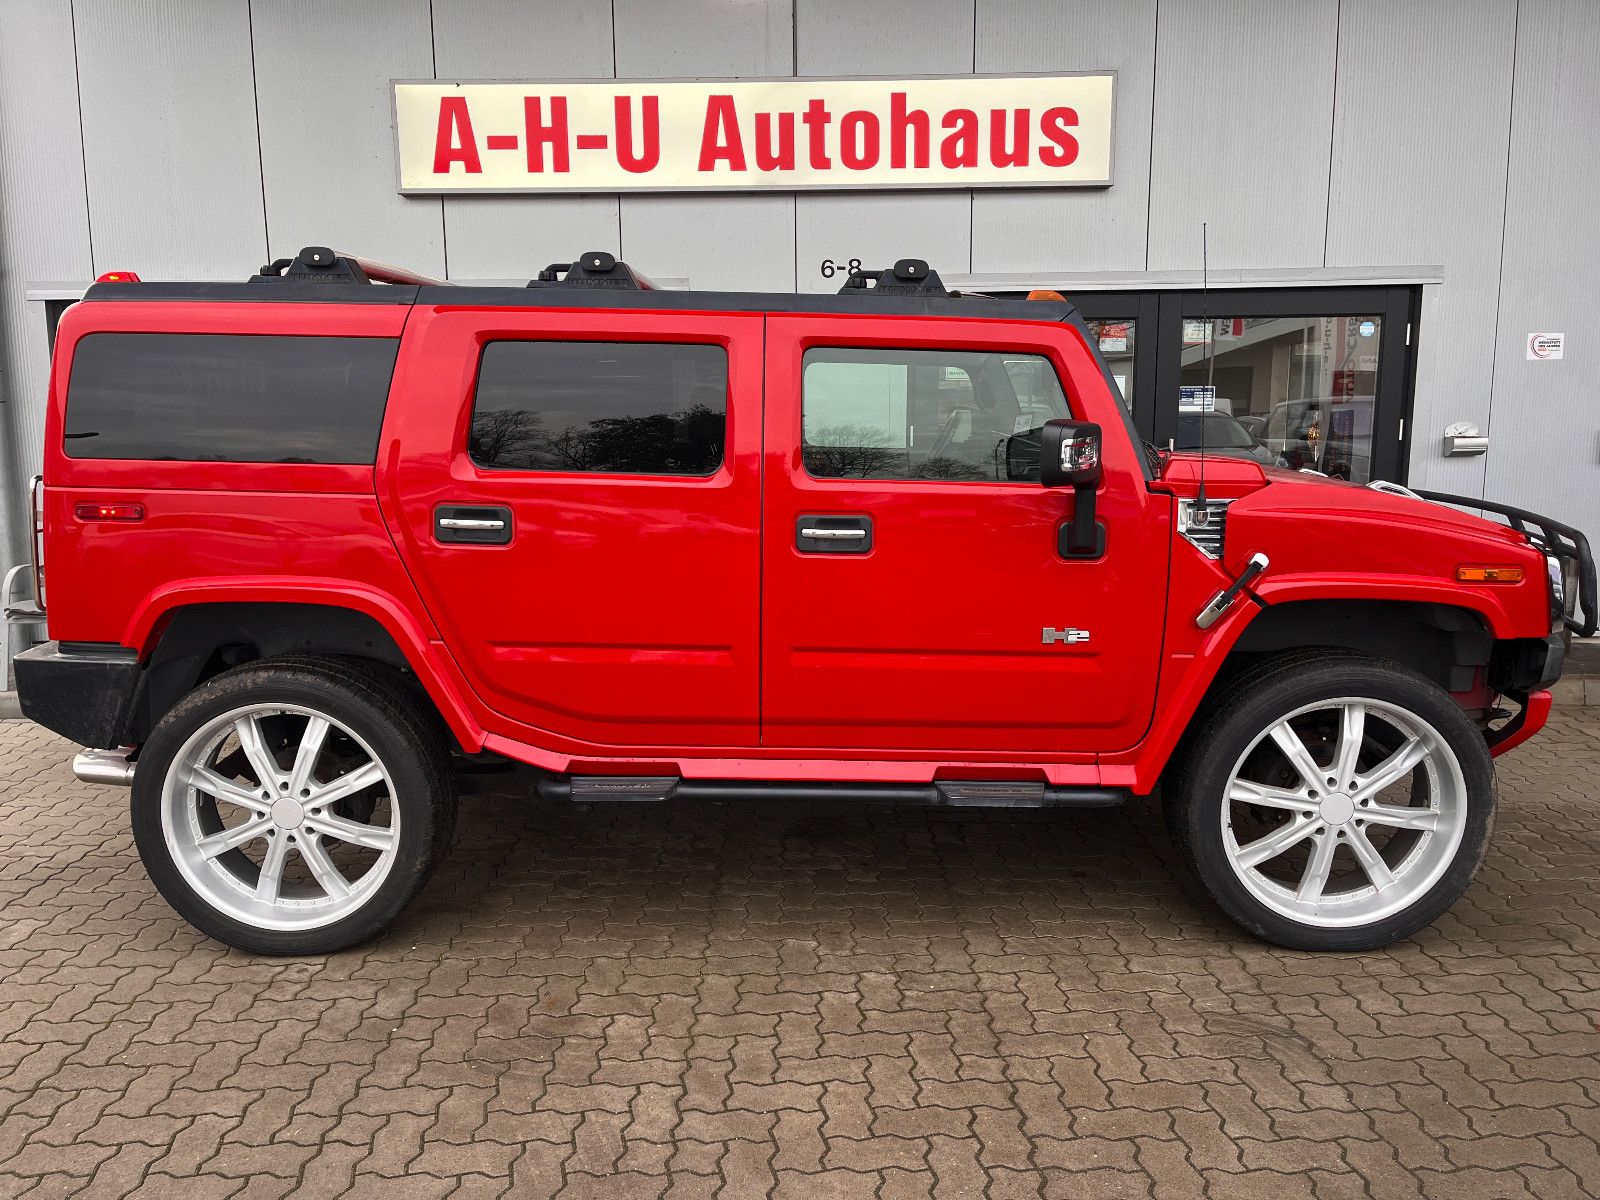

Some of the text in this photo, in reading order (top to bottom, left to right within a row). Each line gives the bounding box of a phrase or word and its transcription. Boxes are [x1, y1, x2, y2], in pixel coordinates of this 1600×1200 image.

[433, 92, 1079, 173] A-H-U Autohaus
[821, 258, 862, 278] 6-8
[1042, 627, 1090, 644] H2
